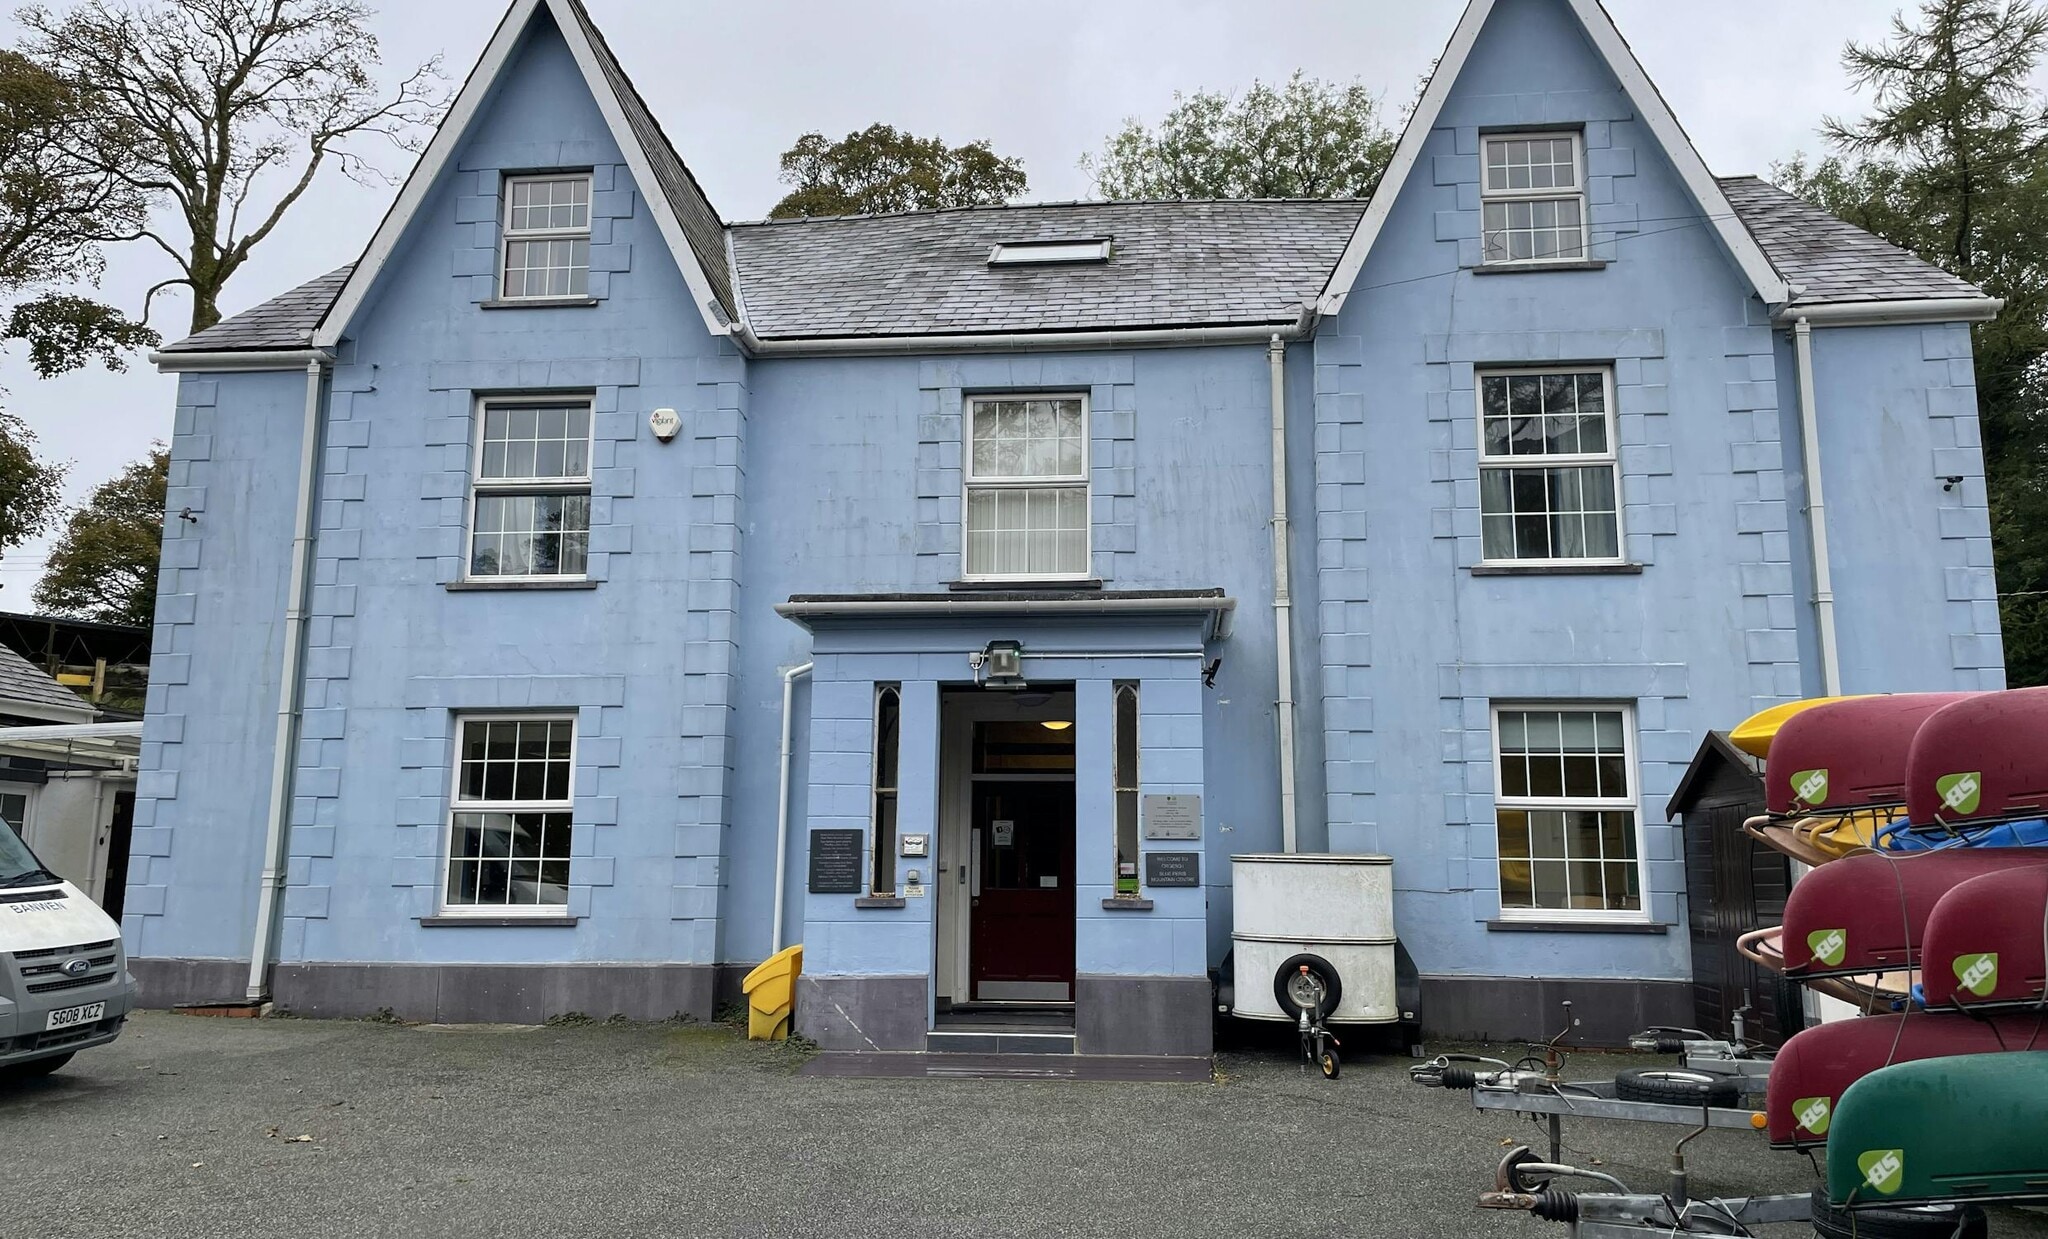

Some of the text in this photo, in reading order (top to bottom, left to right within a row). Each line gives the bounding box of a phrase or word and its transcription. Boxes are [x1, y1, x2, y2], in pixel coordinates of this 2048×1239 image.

[10, 902, 67, 914] BANWEN
[73, 962, 88, 972] Ford
[52, 1004, 101, 1026] SG08 XCZ
